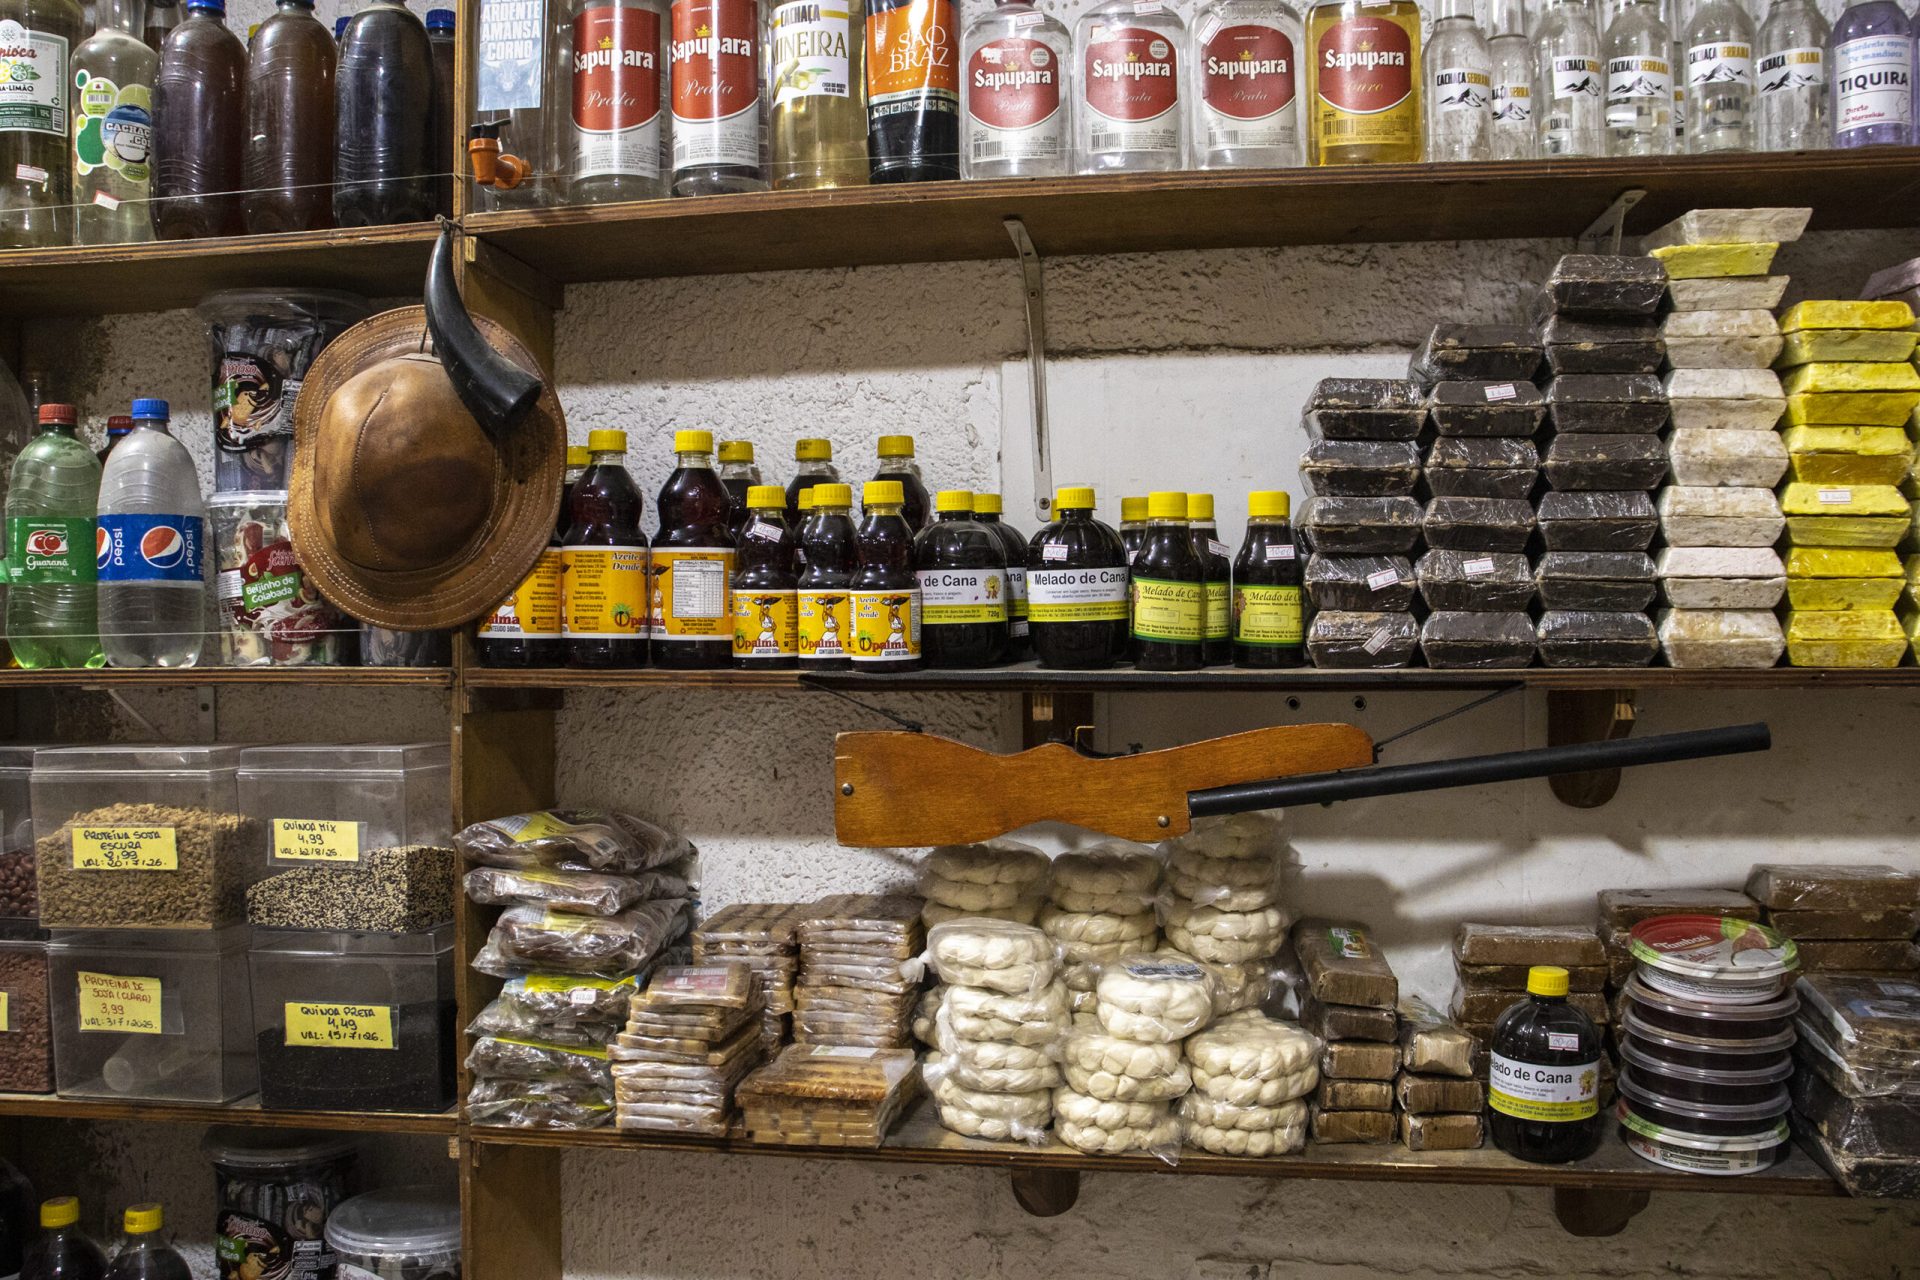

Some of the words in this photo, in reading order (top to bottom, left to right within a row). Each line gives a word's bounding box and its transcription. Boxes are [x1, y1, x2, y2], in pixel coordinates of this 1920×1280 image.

[780, 4, 821, 27] CACHAÇA
[481, 19, 540, 42] AMANSA
[487, 40, 533, 61] CORNO
[672, 36, 751, 63] Sapupara
[574, 49, 654, 74] Sapupara
[889, 47, 950, 73] BRAZ
[1207, 56, 1288, 80] Sapupara
[1325, 49, 1405, 71] Sapupara
[1556, 59, 1586, 72] CACHAÇA
[1610, 60, 1640, 74] CACHAÇA
[1760, 54, 1786, 74] CACHAÇA
[1092, 59, 1171, 81] Sapupara
[974, 68, 1052, 91] Sapupara
[1437, 72, 1466, 86] CACHAÇA
[1839, 71, 1908, 93] TIQUIRA
[681, 79, 734, 99] Prata
[1228, 88, 1268, 102] Prata
[582, 89, 637, 110] Prata
[113, 527, 126, 566] pepsi
[185, 529, 196, 567] pepsi
[26, 555, 69, 570] Guaraná
[612, 552, 640, 561] Azeite
[246, 580, 281, 595] Beijinho
[282, 576, 294, 585] de
[924, 576, 939, 587] de
[942, 574, 977, 587] Cana
[1035, 573, 1076, 585] Melado
[1080, 572, 1096, 584] de
[1100, 571, 1126, 583] Cana
[251, 587, 293, 603] Goiabada
[1142, 585, 1174, 597] Melado
[1175, 587, 1185, 597] de
[1249, 591, 1283, 601] Melado
[1283, 591, 1292, 601] de
[736, 635, 779, 649] Opalma
[800, 635, 842, 649] Opalma
[859, 636, 908, 653] Opalma
[132, 830, 161, 839] SOJA
[297, 833, 325, 845] 4,99
[100, 841, 142, 850] ESCURA
[133, 981, 145, 992] DE
[92, 988, 115, 998] SOJA
[116, 992, 152, 1004] (CLARA)
[100, 1002, 125, 1015] 3,99
[300, 1005, 341, 1016] QUINOA
[343, 1006, 376, 1017] PRETA
[327, 1016, 358, 1031] 4,49
[300, 1030, 324, 1040] VAL:
[1514, 1067, 1531, 1081] de
[1534, 1070, 1572, 1084] Cana
